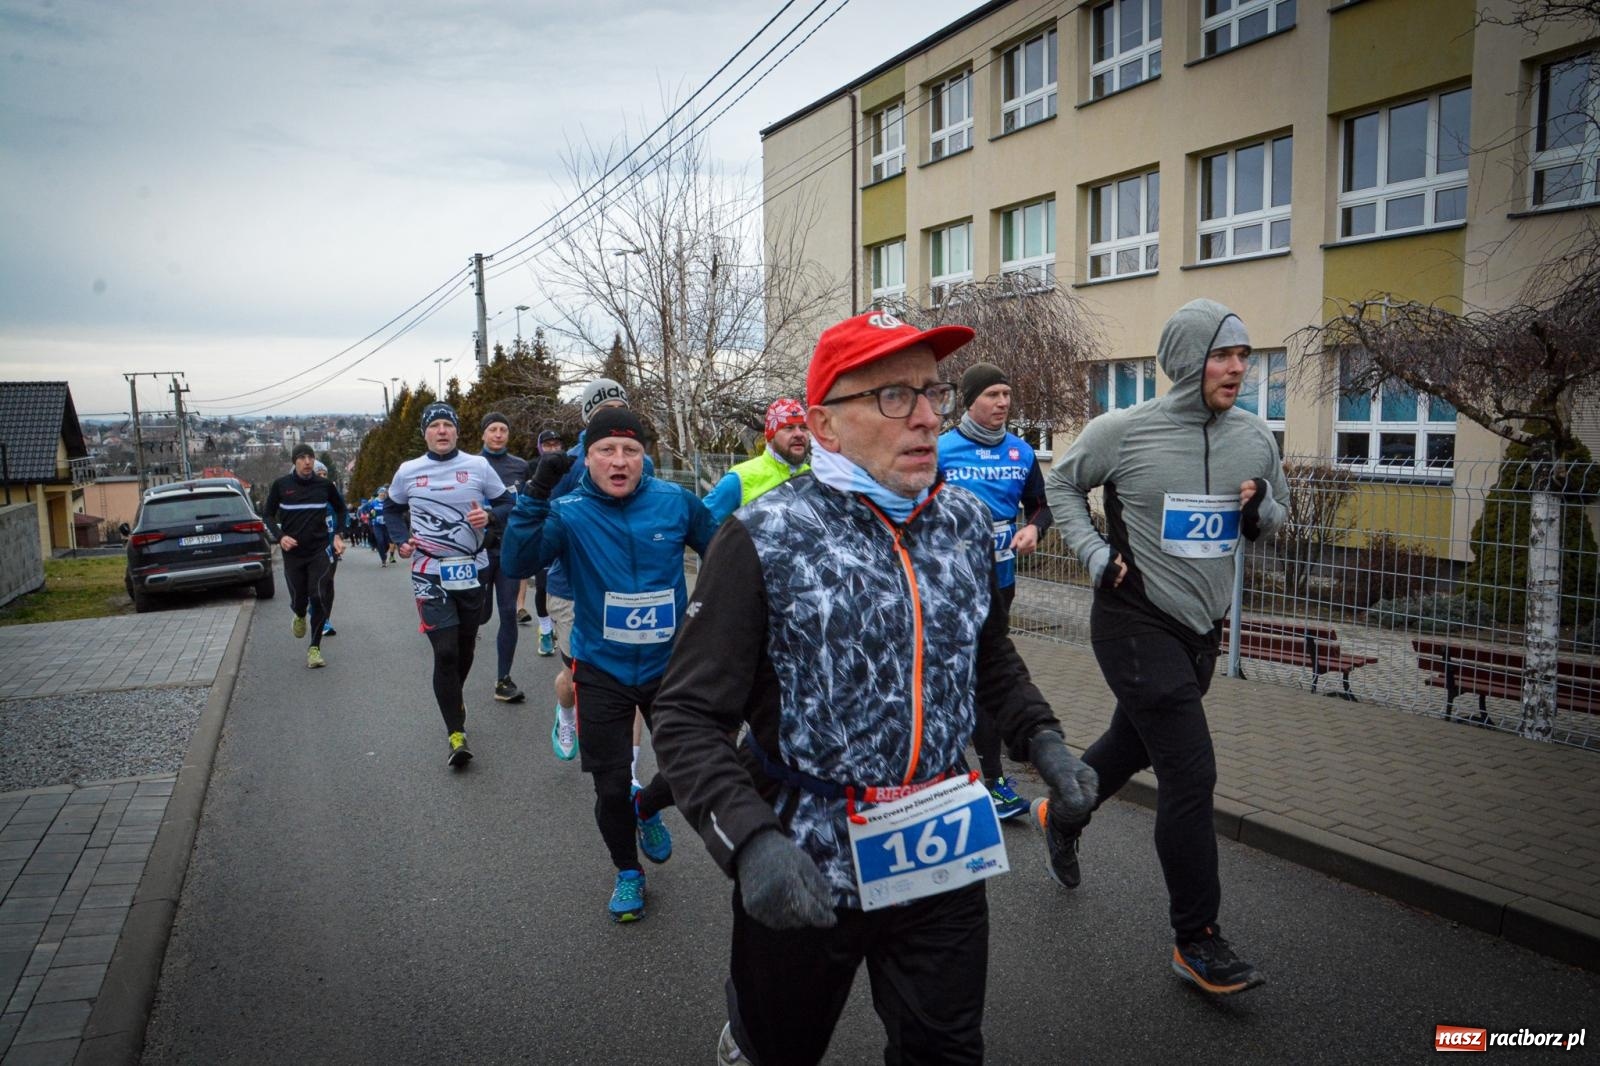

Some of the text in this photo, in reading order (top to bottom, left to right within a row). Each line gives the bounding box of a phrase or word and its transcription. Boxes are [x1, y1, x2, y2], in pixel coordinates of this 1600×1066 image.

[945, 466, 1028, 481] RUNNERS
[1186, 512, 1223, 539] 20
[447, 564, 473, 580] 168
[625, 606, 658, 629] 64
[882, 806, 972, 873] 167
